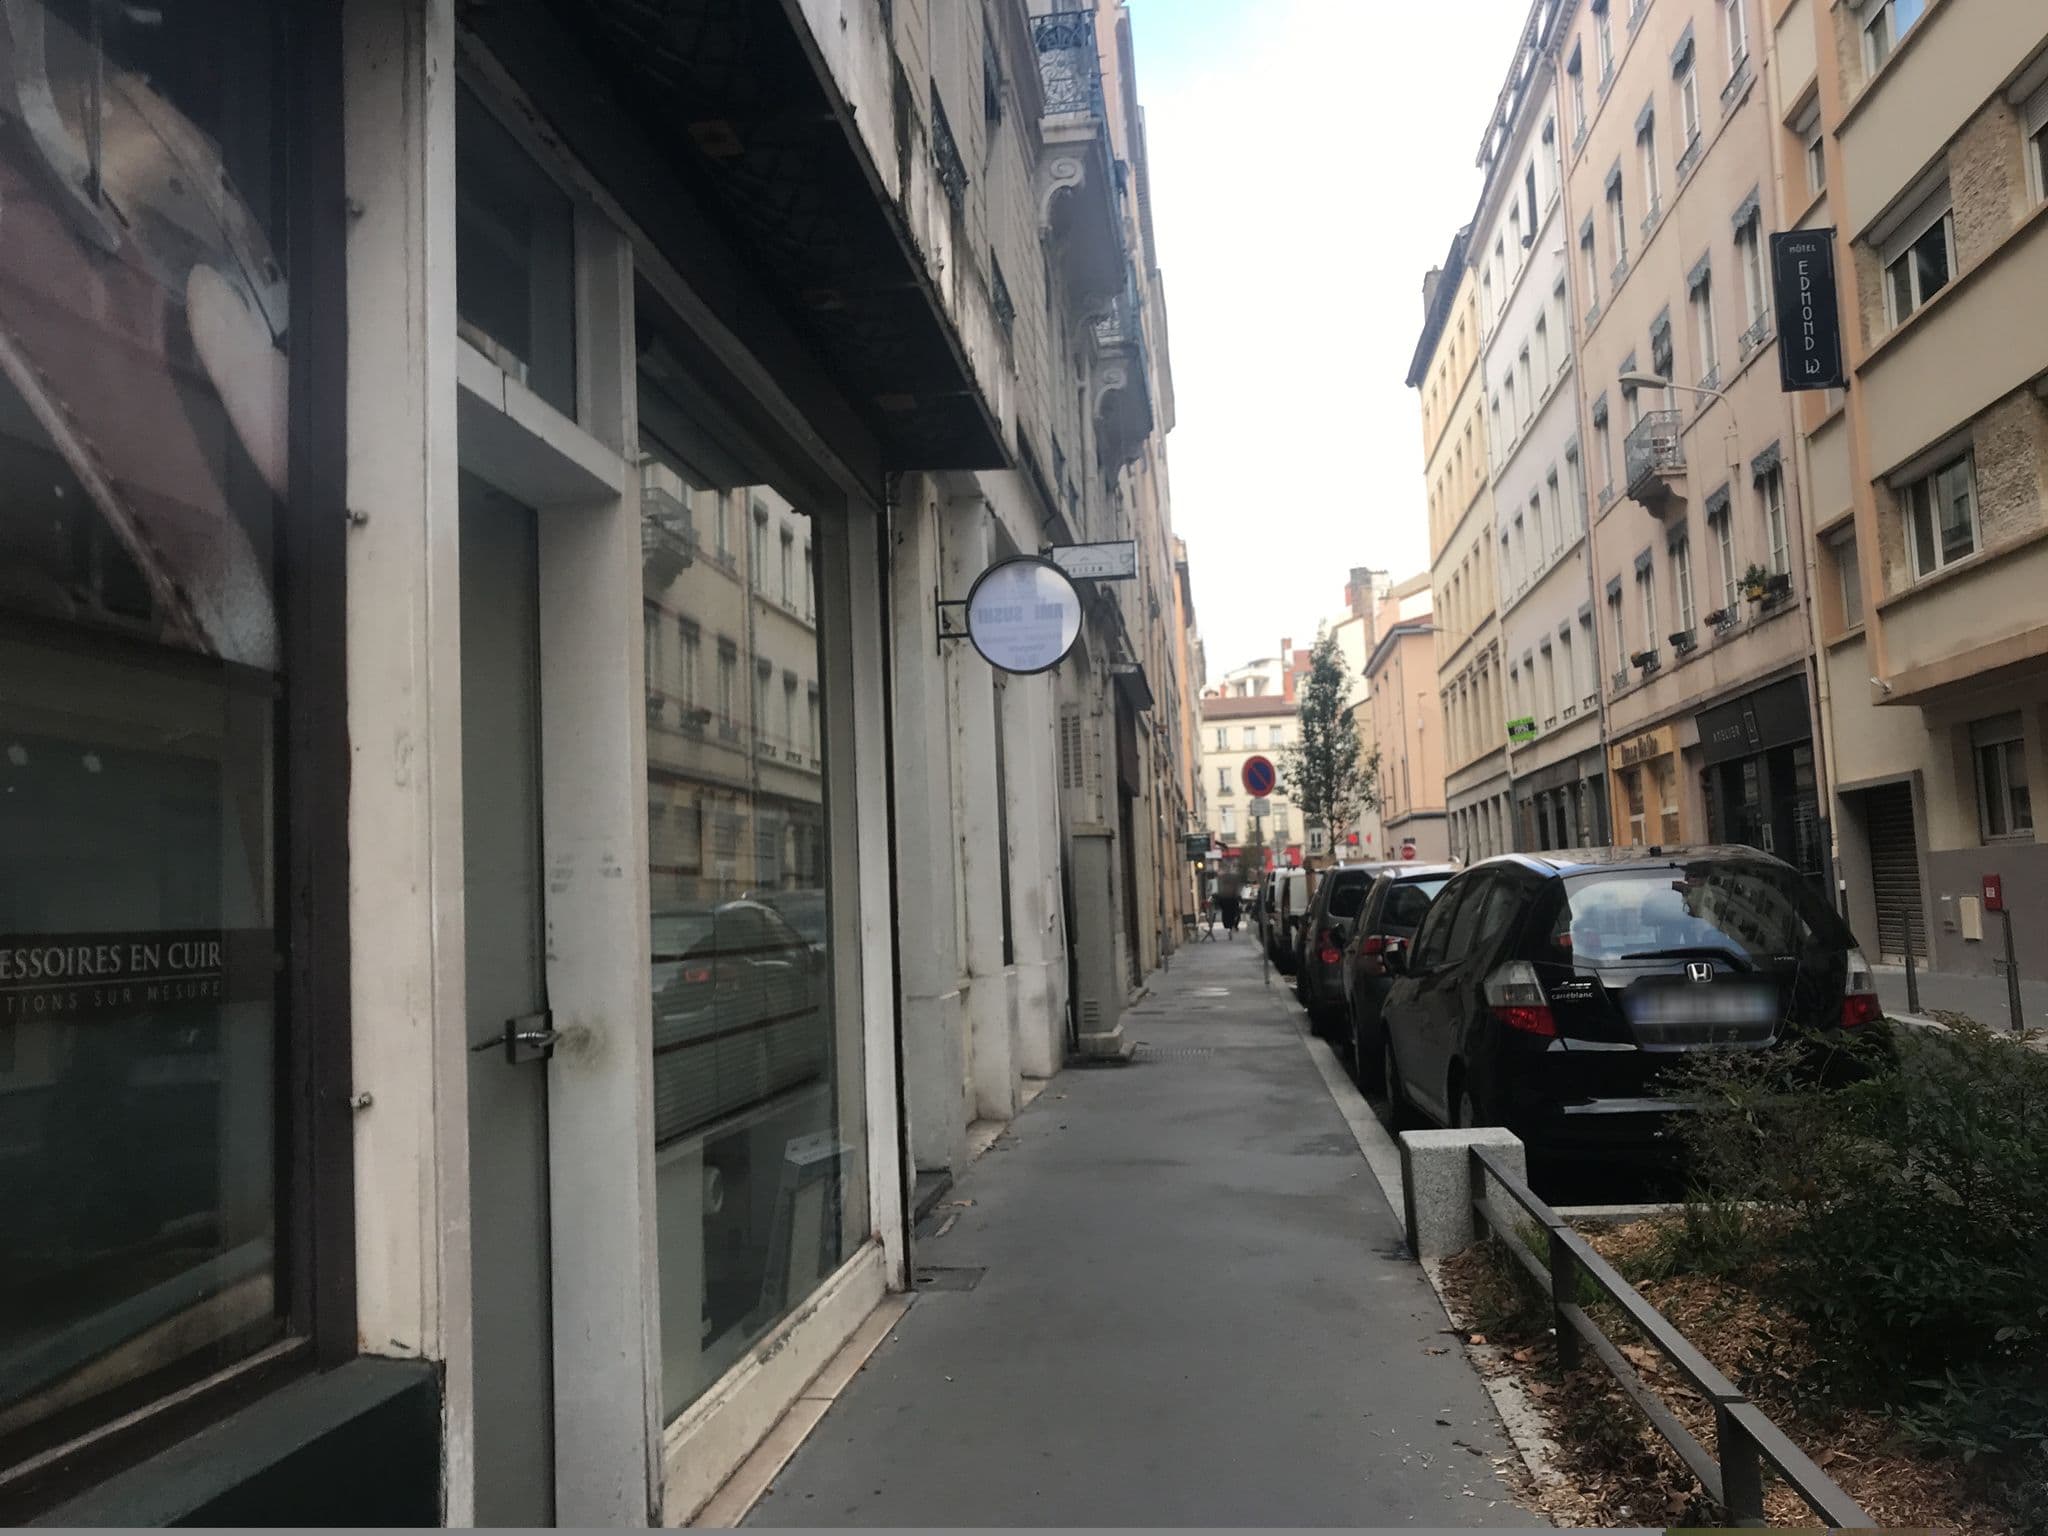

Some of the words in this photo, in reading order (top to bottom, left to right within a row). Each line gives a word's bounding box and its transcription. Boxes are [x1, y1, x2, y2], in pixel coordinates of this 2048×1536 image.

[1798, 260, 1815, 351] EDMOND
[130, 944, 160, 972] EN
[168, 942, 222, 969] CUIR
[94, 988, 131, 1008] SUR
[147, 981, 221, 1001] MESURE
